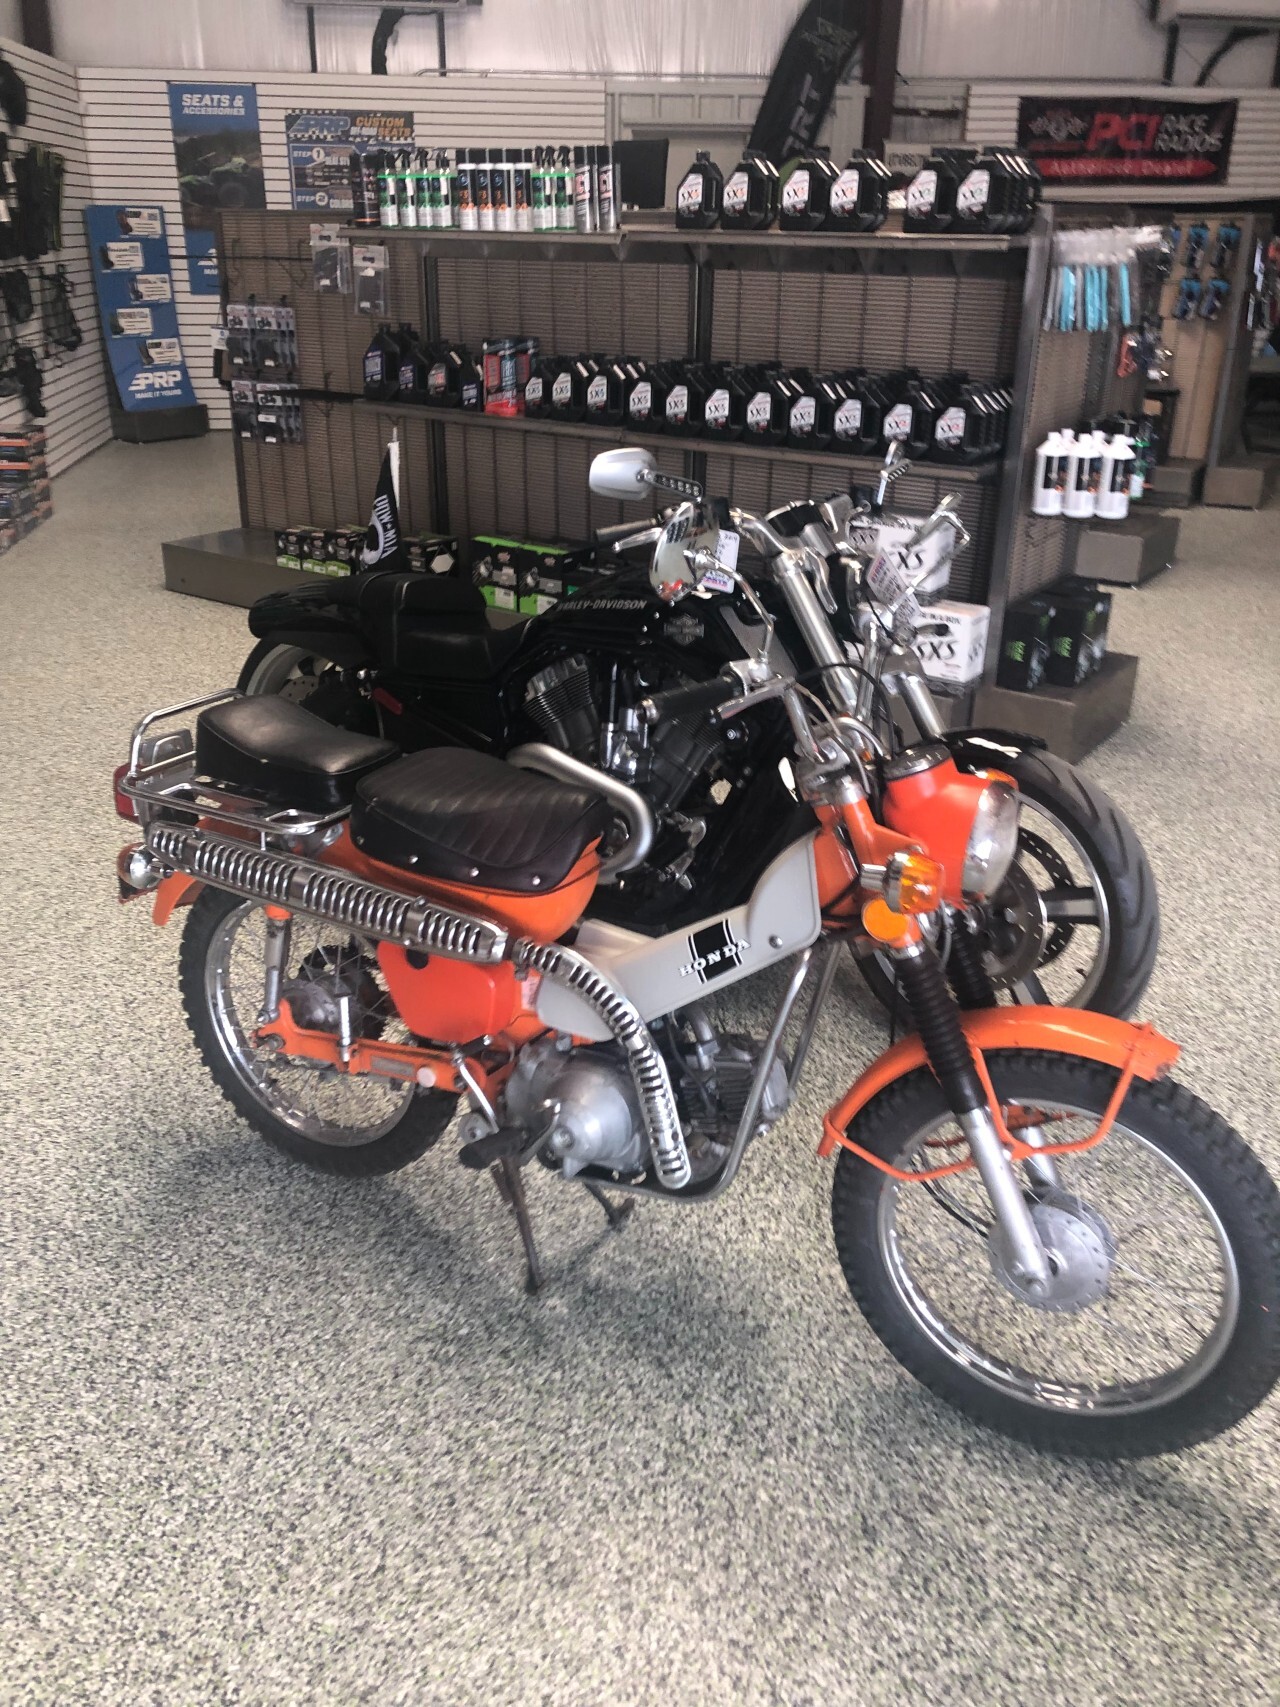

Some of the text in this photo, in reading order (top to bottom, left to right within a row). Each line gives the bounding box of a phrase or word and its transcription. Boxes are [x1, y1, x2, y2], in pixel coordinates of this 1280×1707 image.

[182, 93, 244, 107] SEATS &
[182, 106, 245, 116] ACCESSORIES
[356, 116, 405, 127] CUSTOM
[378, 127, 411, 137] SEATS
[128, 370, 182, 391] PRP
[556, 600, 647, 612] HARLEY-DAVIDSON
[916, 640, 959, 661] SXS
[679, 939, 751, 977] HONDA
